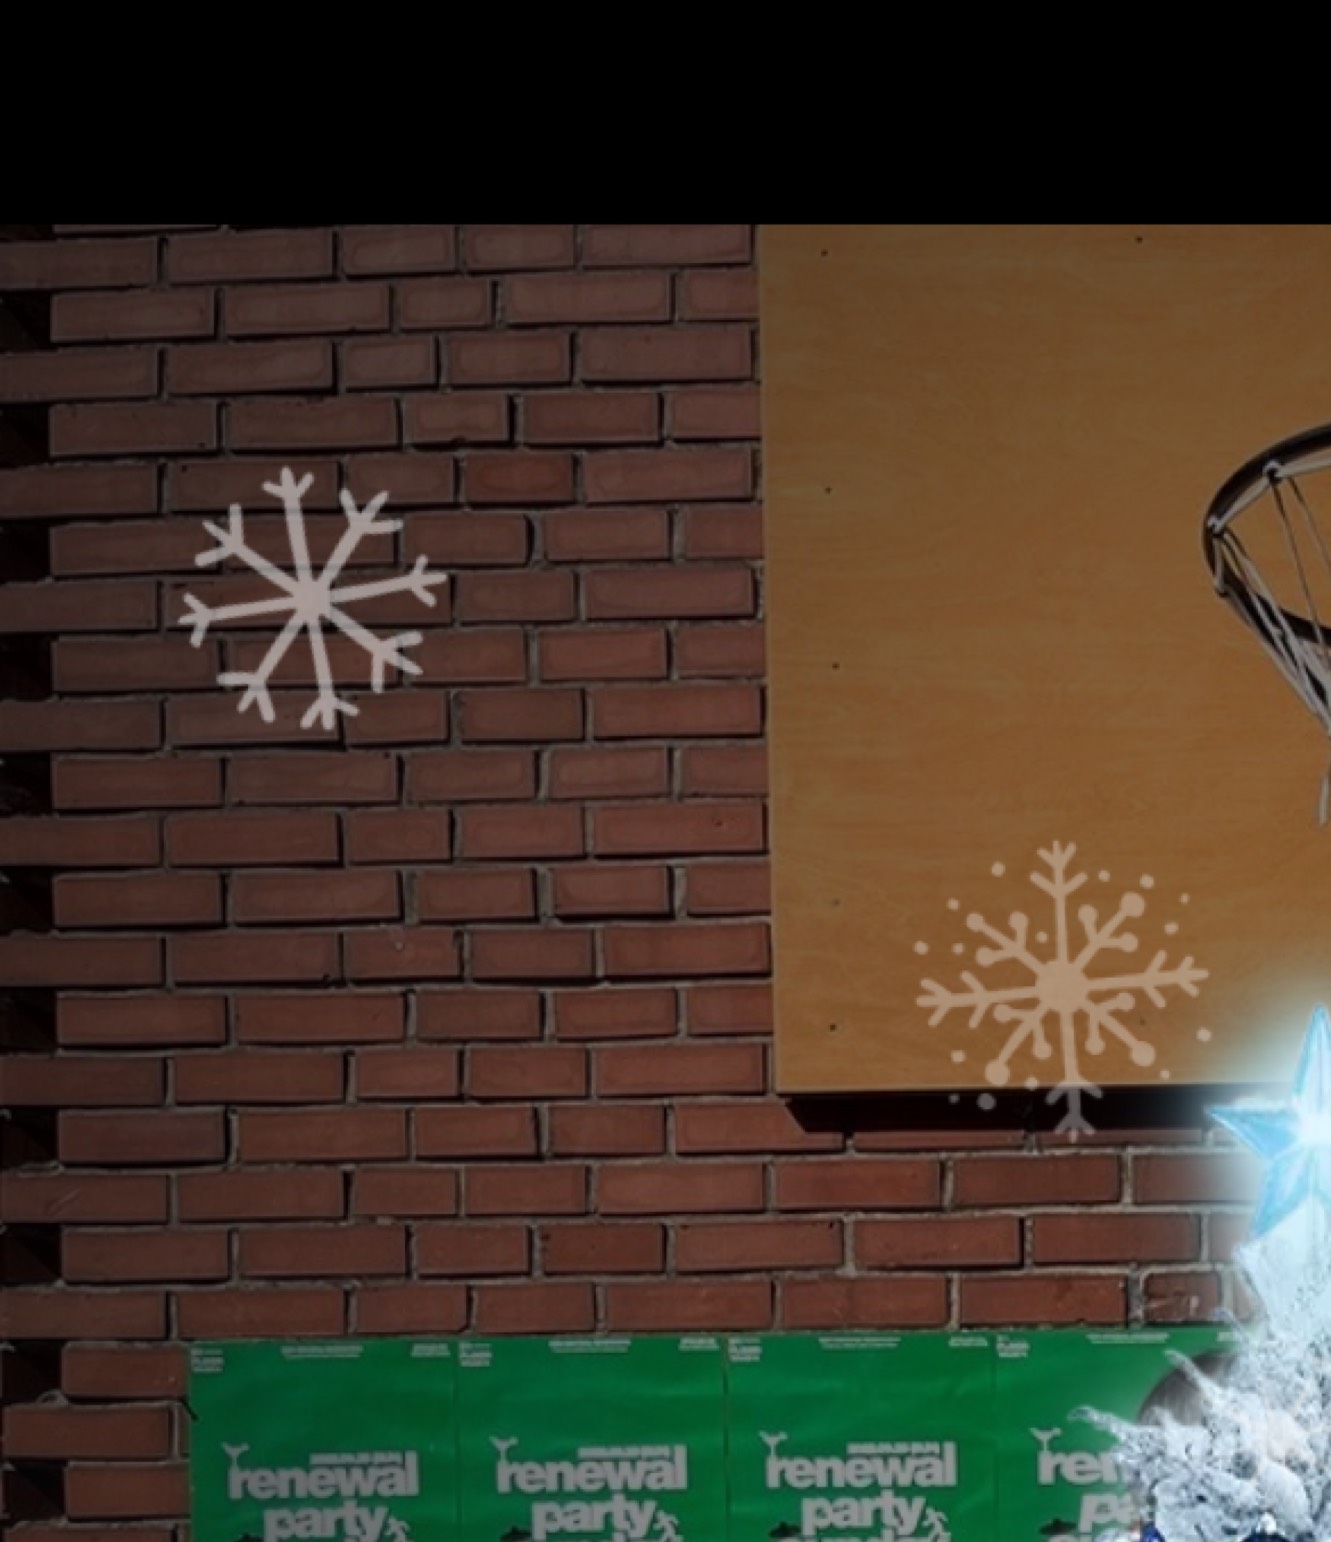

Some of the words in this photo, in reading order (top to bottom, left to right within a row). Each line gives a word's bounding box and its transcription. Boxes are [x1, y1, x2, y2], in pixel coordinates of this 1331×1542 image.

[230, 1453, 418, 1497] renewal
[498, 1446, 686, 1491] renewal
[768, 1442, 955, 1487] renewal
[532, 1494, 656, 1539] party
[802, 1490, 925, 1535] party
